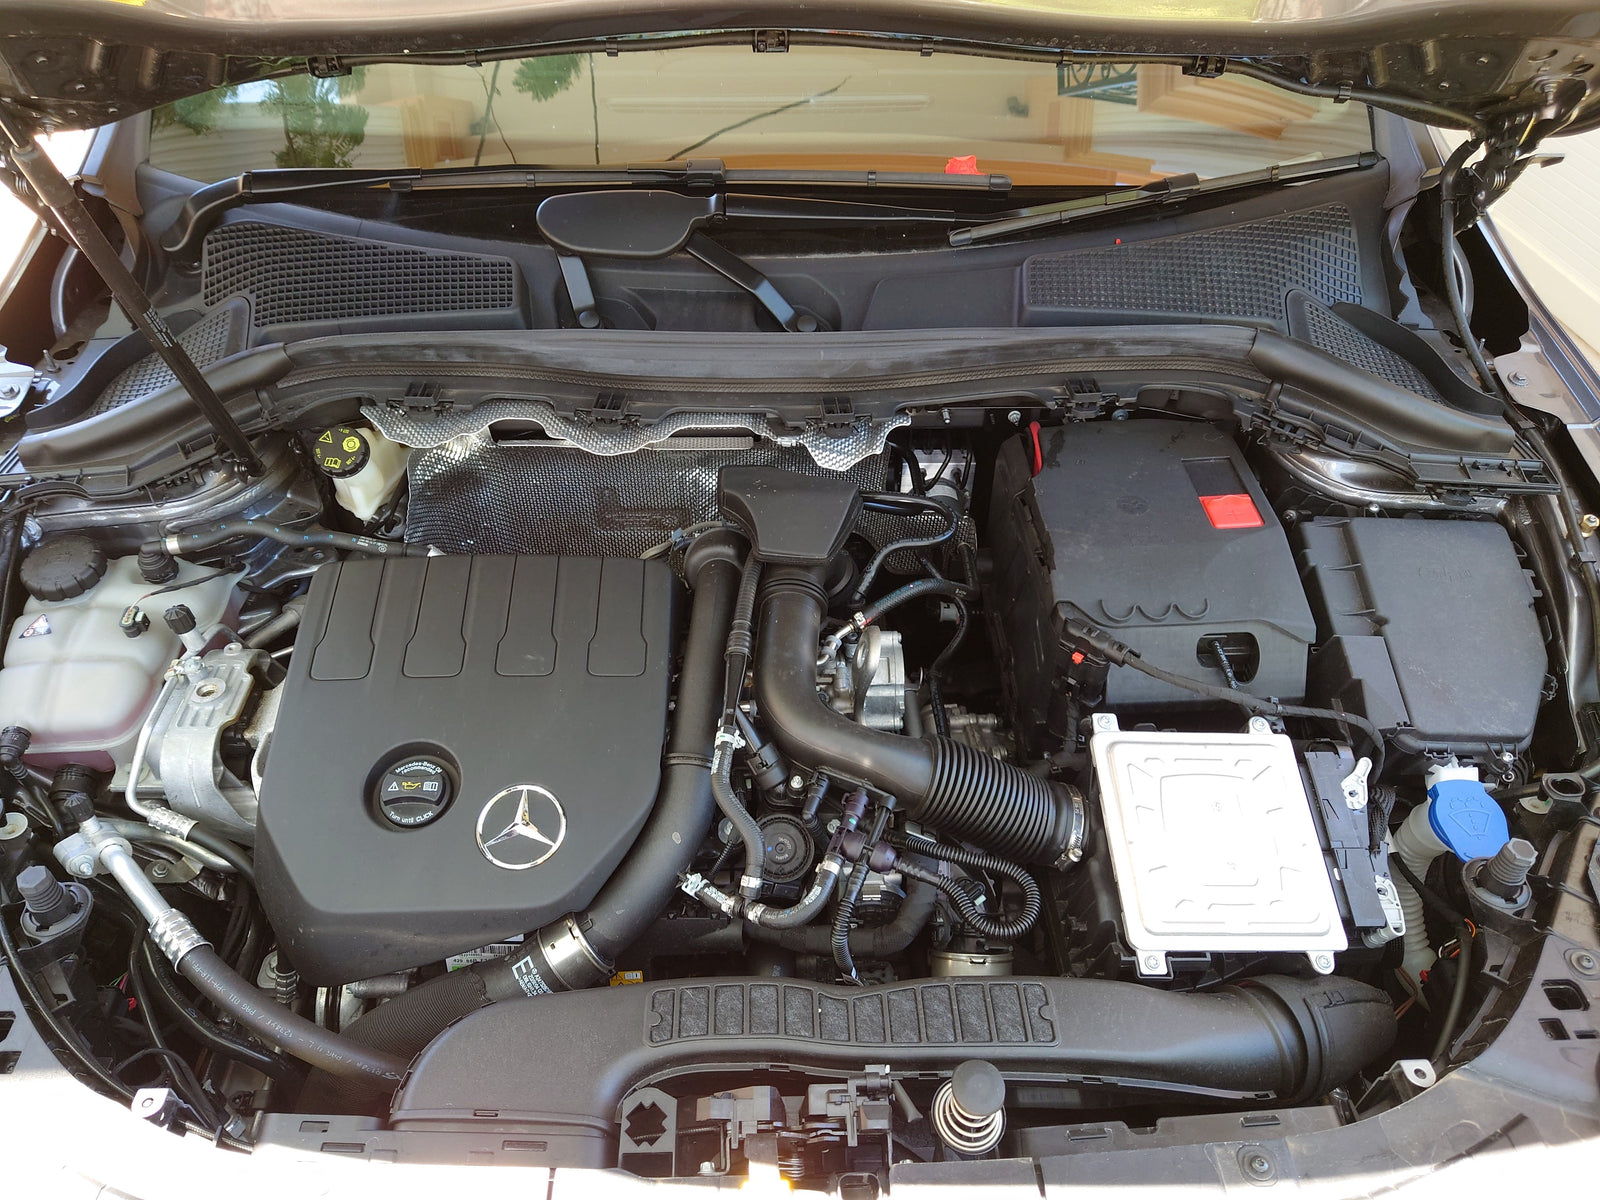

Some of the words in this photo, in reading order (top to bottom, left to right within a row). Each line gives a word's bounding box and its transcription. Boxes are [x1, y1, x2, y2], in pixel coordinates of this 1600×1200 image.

[395, 761, 436, 773] Mercedes-Benz
[402, 765, 436, 774] recommended
[389, 811, 400, 821] Turn
[415, 811, 433, 822] CLICK
[240, 1003, 257, 1016] PAG
